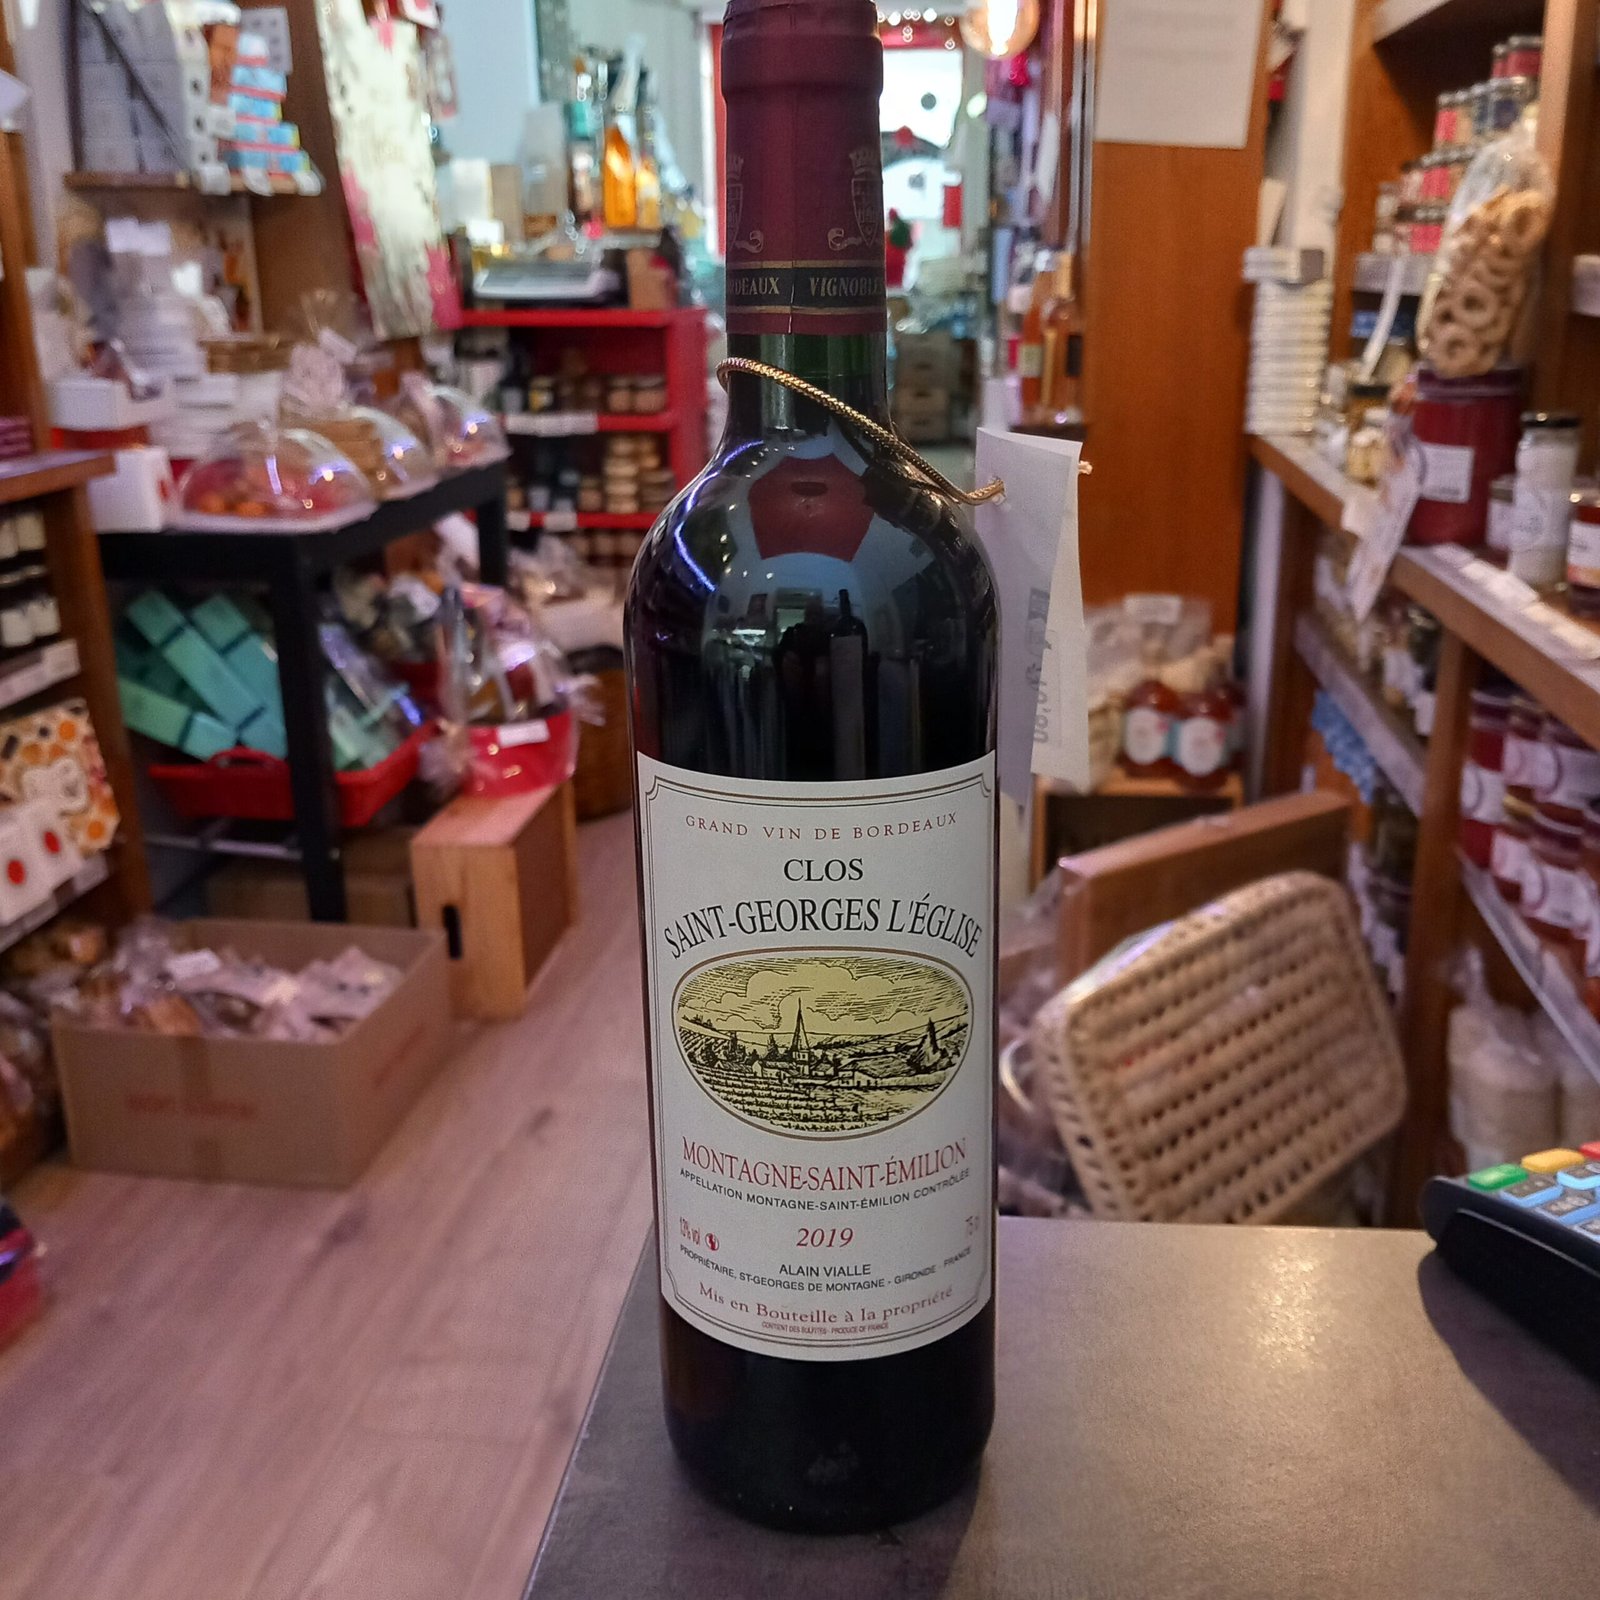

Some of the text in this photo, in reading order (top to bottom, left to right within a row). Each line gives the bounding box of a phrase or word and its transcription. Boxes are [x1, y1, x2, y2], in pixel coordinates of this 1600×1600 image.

[686, 812, 957, 840] GRAND VIN DE BORDEAUX
[783, 858, 864, 882] CLOS
[664, 892, 983, 960] SAINT-GEORGES L'ÉGLISE
[683, 1136, 966, 1191] MONTAGNE-SAINT-ÉMILION
[680, 1167, 743, 1200] APPELLATION
[746, 1192, 910, 1211] MONTAGNE-SAINT-ÉMILION
[796, 1227, 854, 1248] 2019
[739, 1272, 805, 1291] ST-GEORGES
[807, 1282, 823, 1292] DE
[826, 1279, 885, 1292] MONTAGNE
[894, 1265, 937, 1285] GIRONDE
[779, 1264, 872, 1277] ALAIN VIALLE
[700, 1281, 953, 1323] Mis en Bouteille à la propriété
